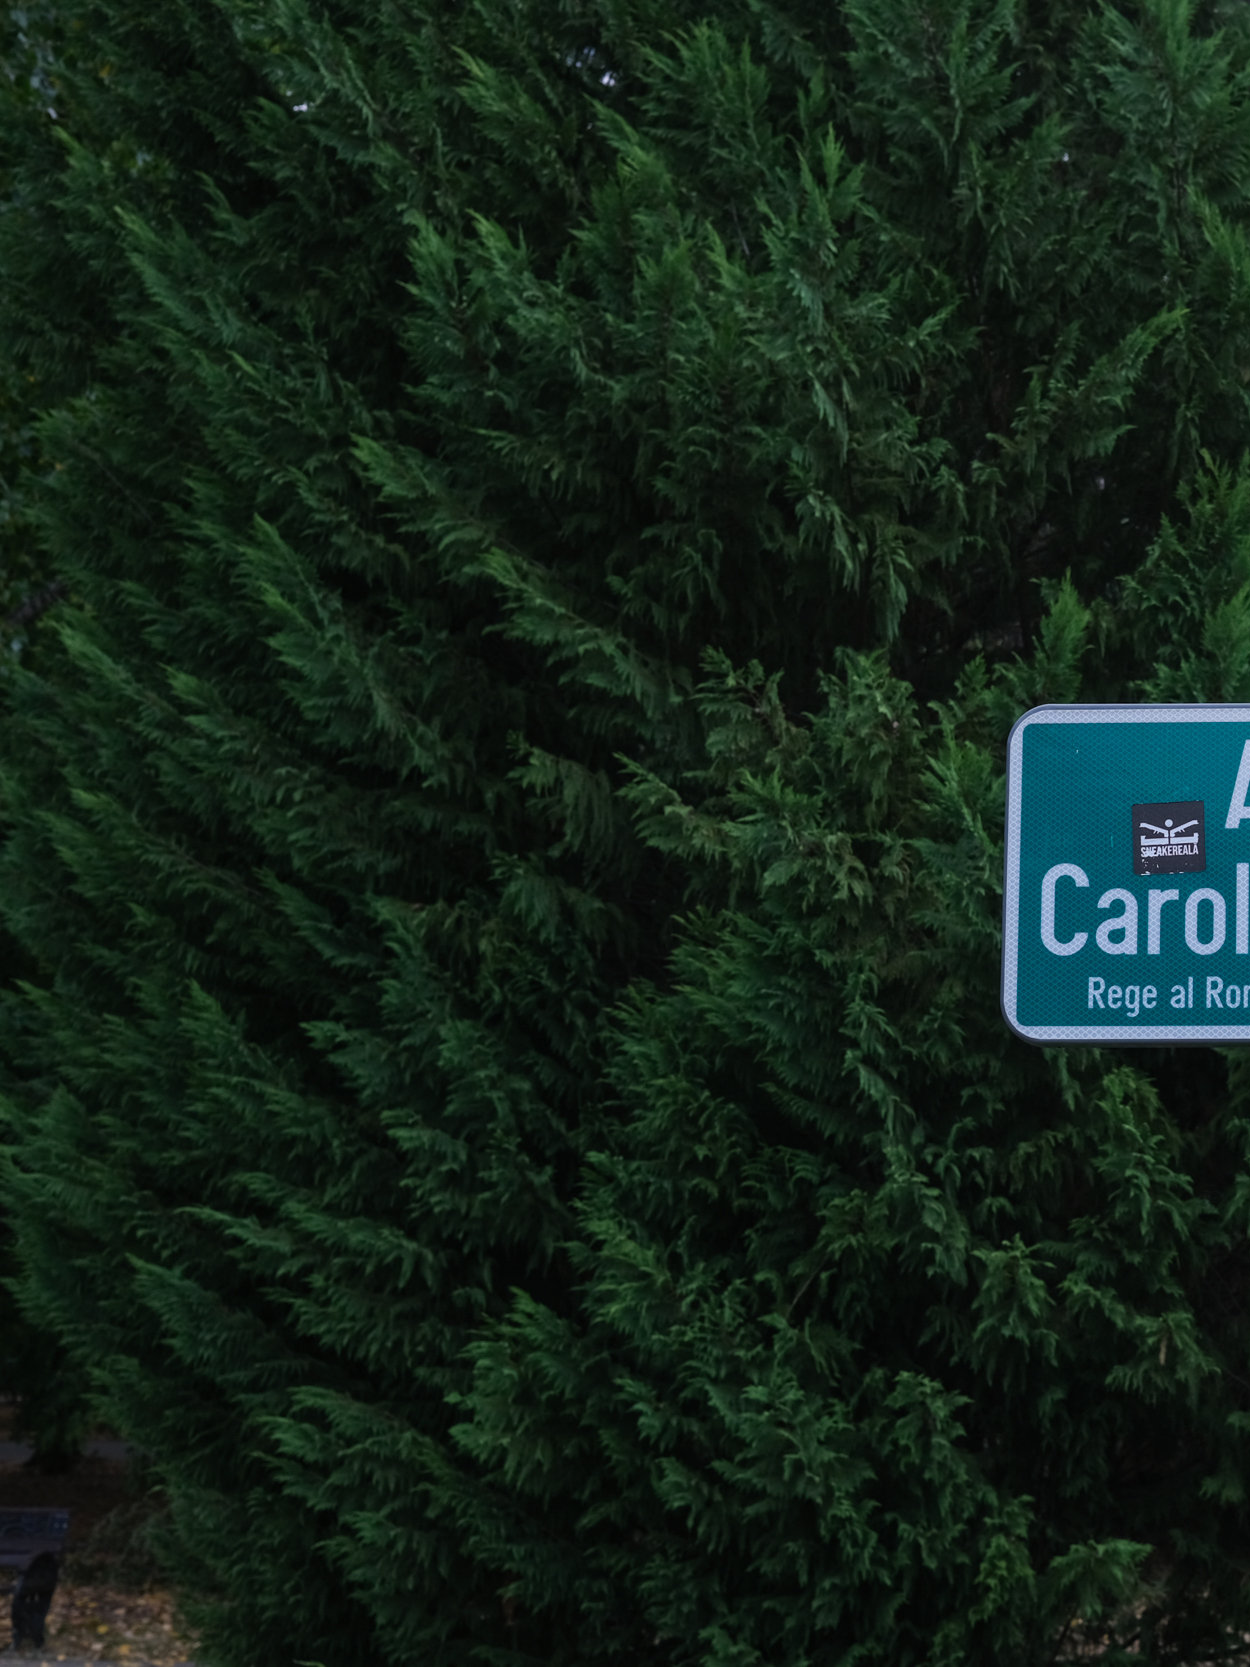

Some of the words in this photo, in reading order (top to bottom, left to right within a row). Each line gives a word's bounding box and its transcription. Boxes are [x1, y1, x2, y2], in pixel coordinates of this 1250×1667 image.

[1040, 863, 1250, 957] Carol
[1088, 976, 1158, 1018] Rege
[1170, 976, 1194, 1009] al
